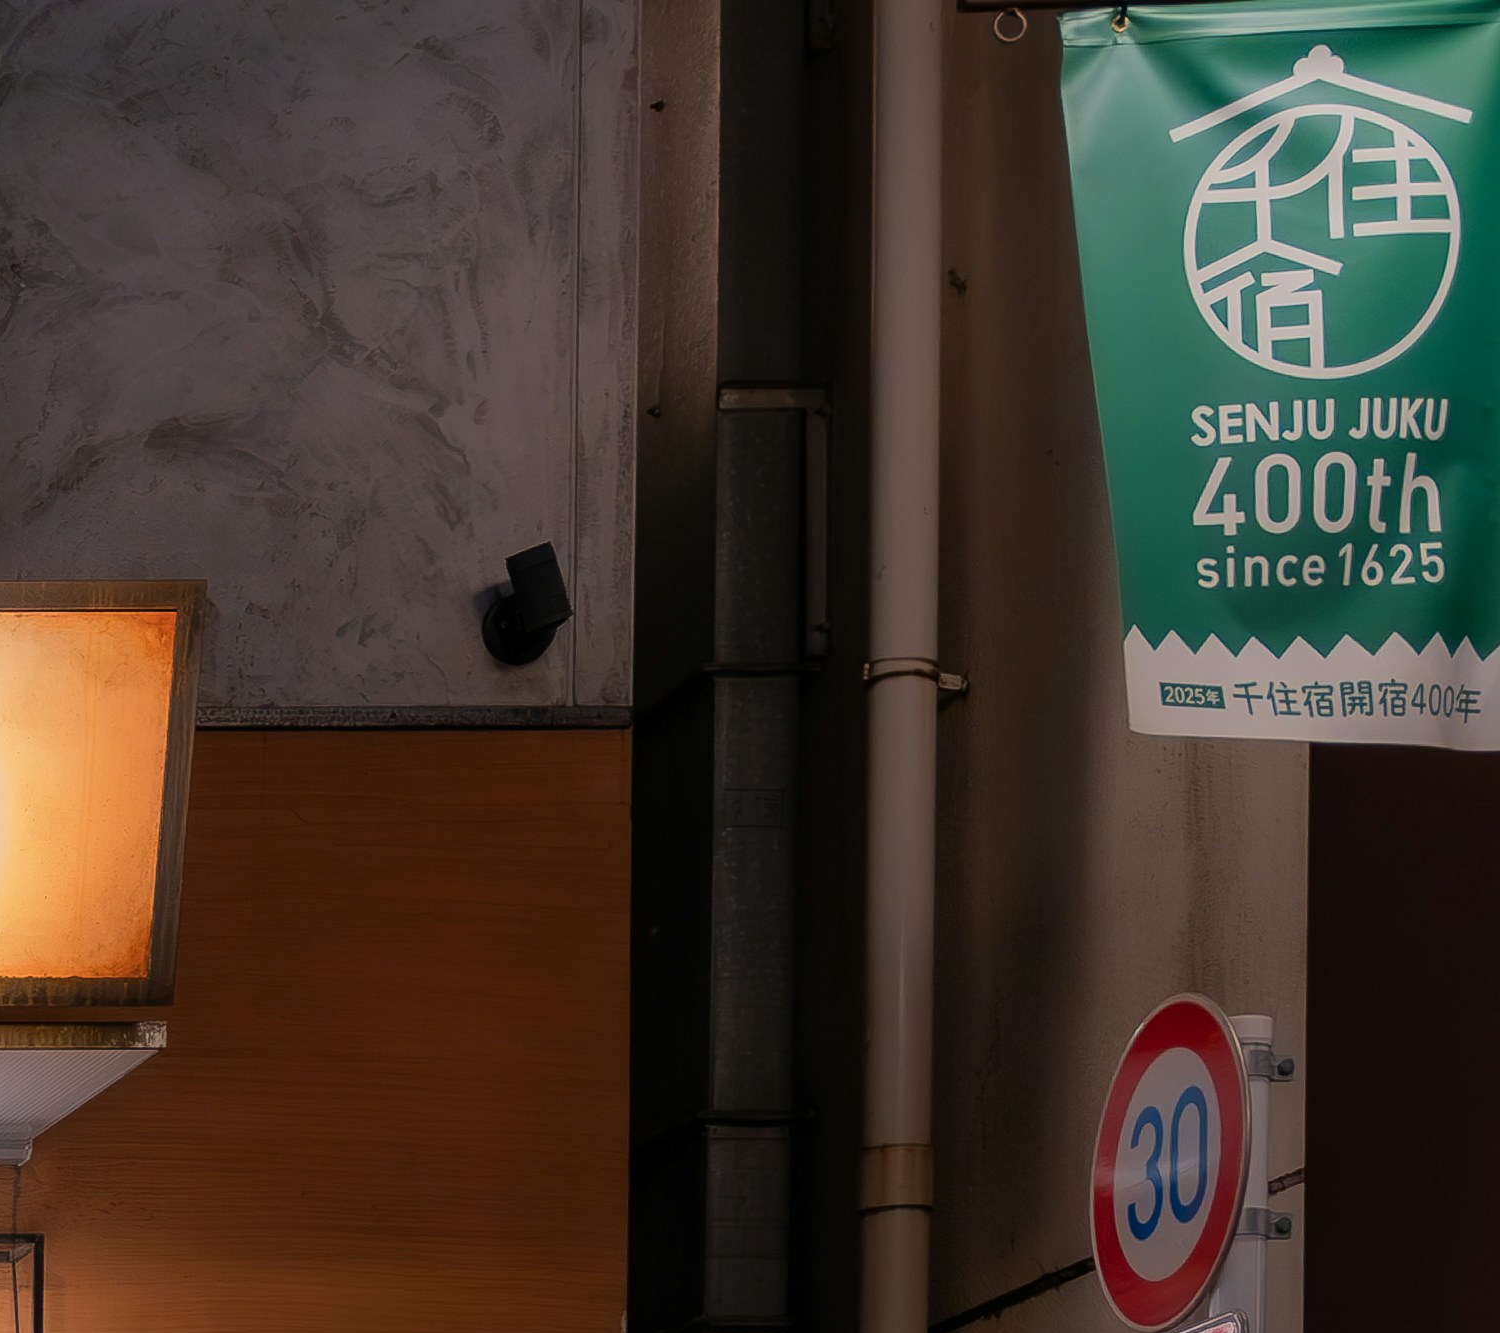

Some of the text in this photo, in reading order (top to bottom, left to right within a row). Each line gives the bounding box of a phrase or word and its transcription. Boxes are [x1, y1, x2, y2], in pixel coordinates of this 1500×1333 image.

[1190, 397, 1449, 447] SENJU JUKU
[1192, 451, 1443, 537] 400th
[1196, 542, 1446, 589] since 1625
[1163, 679, 1482, 723] 2025年 千住宿開宿400年
[1126, 1083, 1211, 1243] 30
